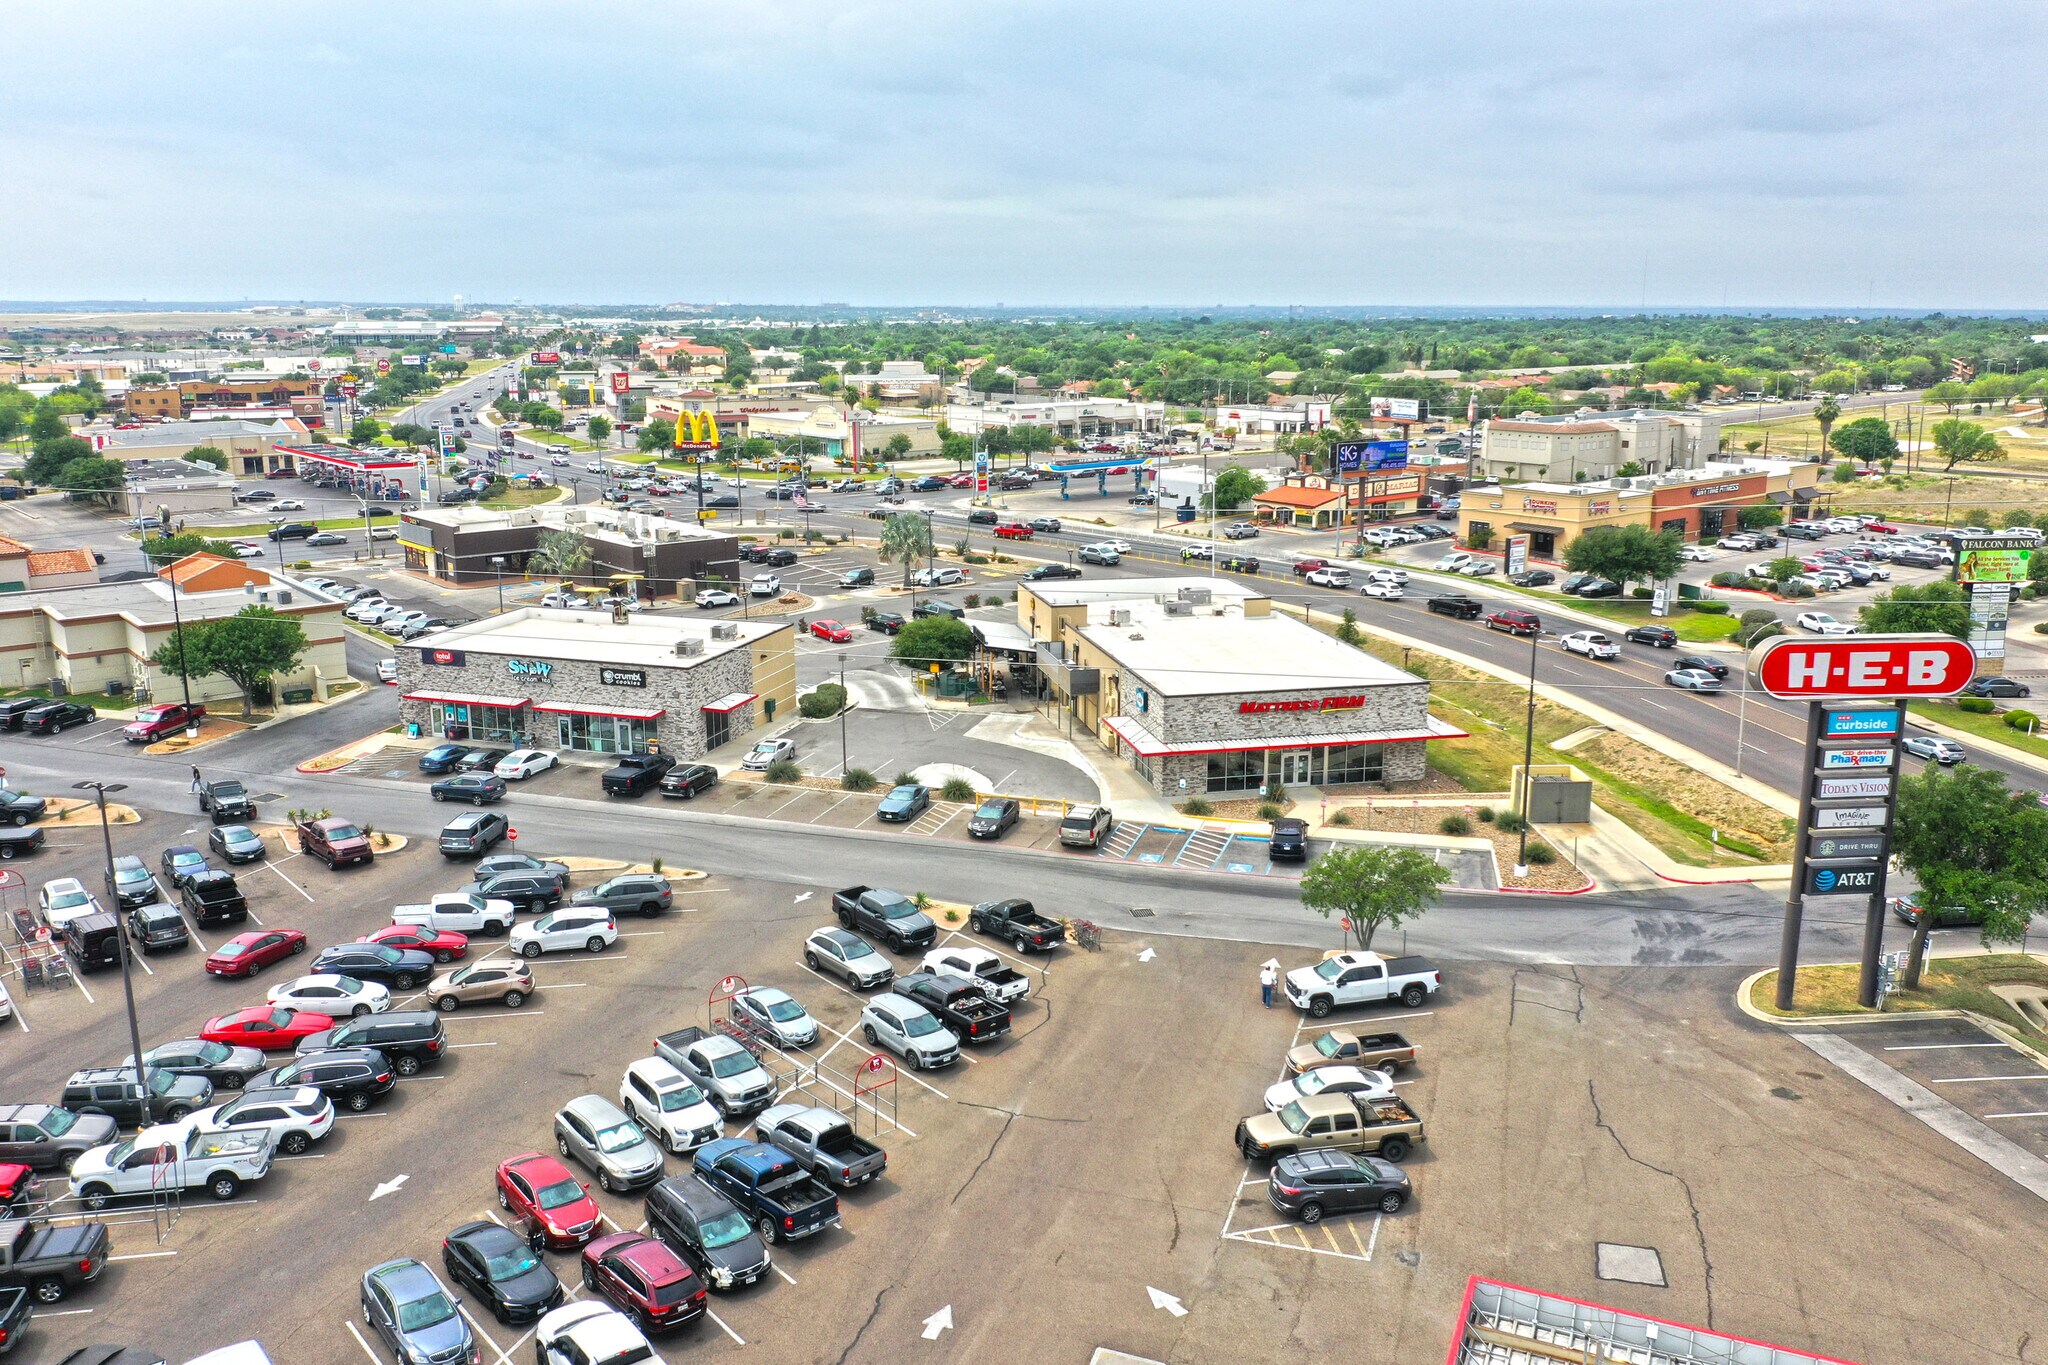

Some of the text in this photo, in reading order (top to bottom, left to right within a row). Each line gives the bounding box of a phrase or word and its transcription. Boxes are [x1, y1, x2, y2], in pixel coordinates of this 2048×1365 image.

[1340, 445, 1358, 461] SKG
[1696, 483, 1740, 496] ANYTIME FITNESS
[1969, 540, 2034, 549] FALCON BANK
[614, 673, 641, 681] crumbl
[1239, 696, 1365, 714] MATTRESS FIRM
[1835, 719, 1888, 730] curbside
[1822, 782, 1889, 794] TODAY'S VISION
[1838, 872, 1875, 886] AT&T
